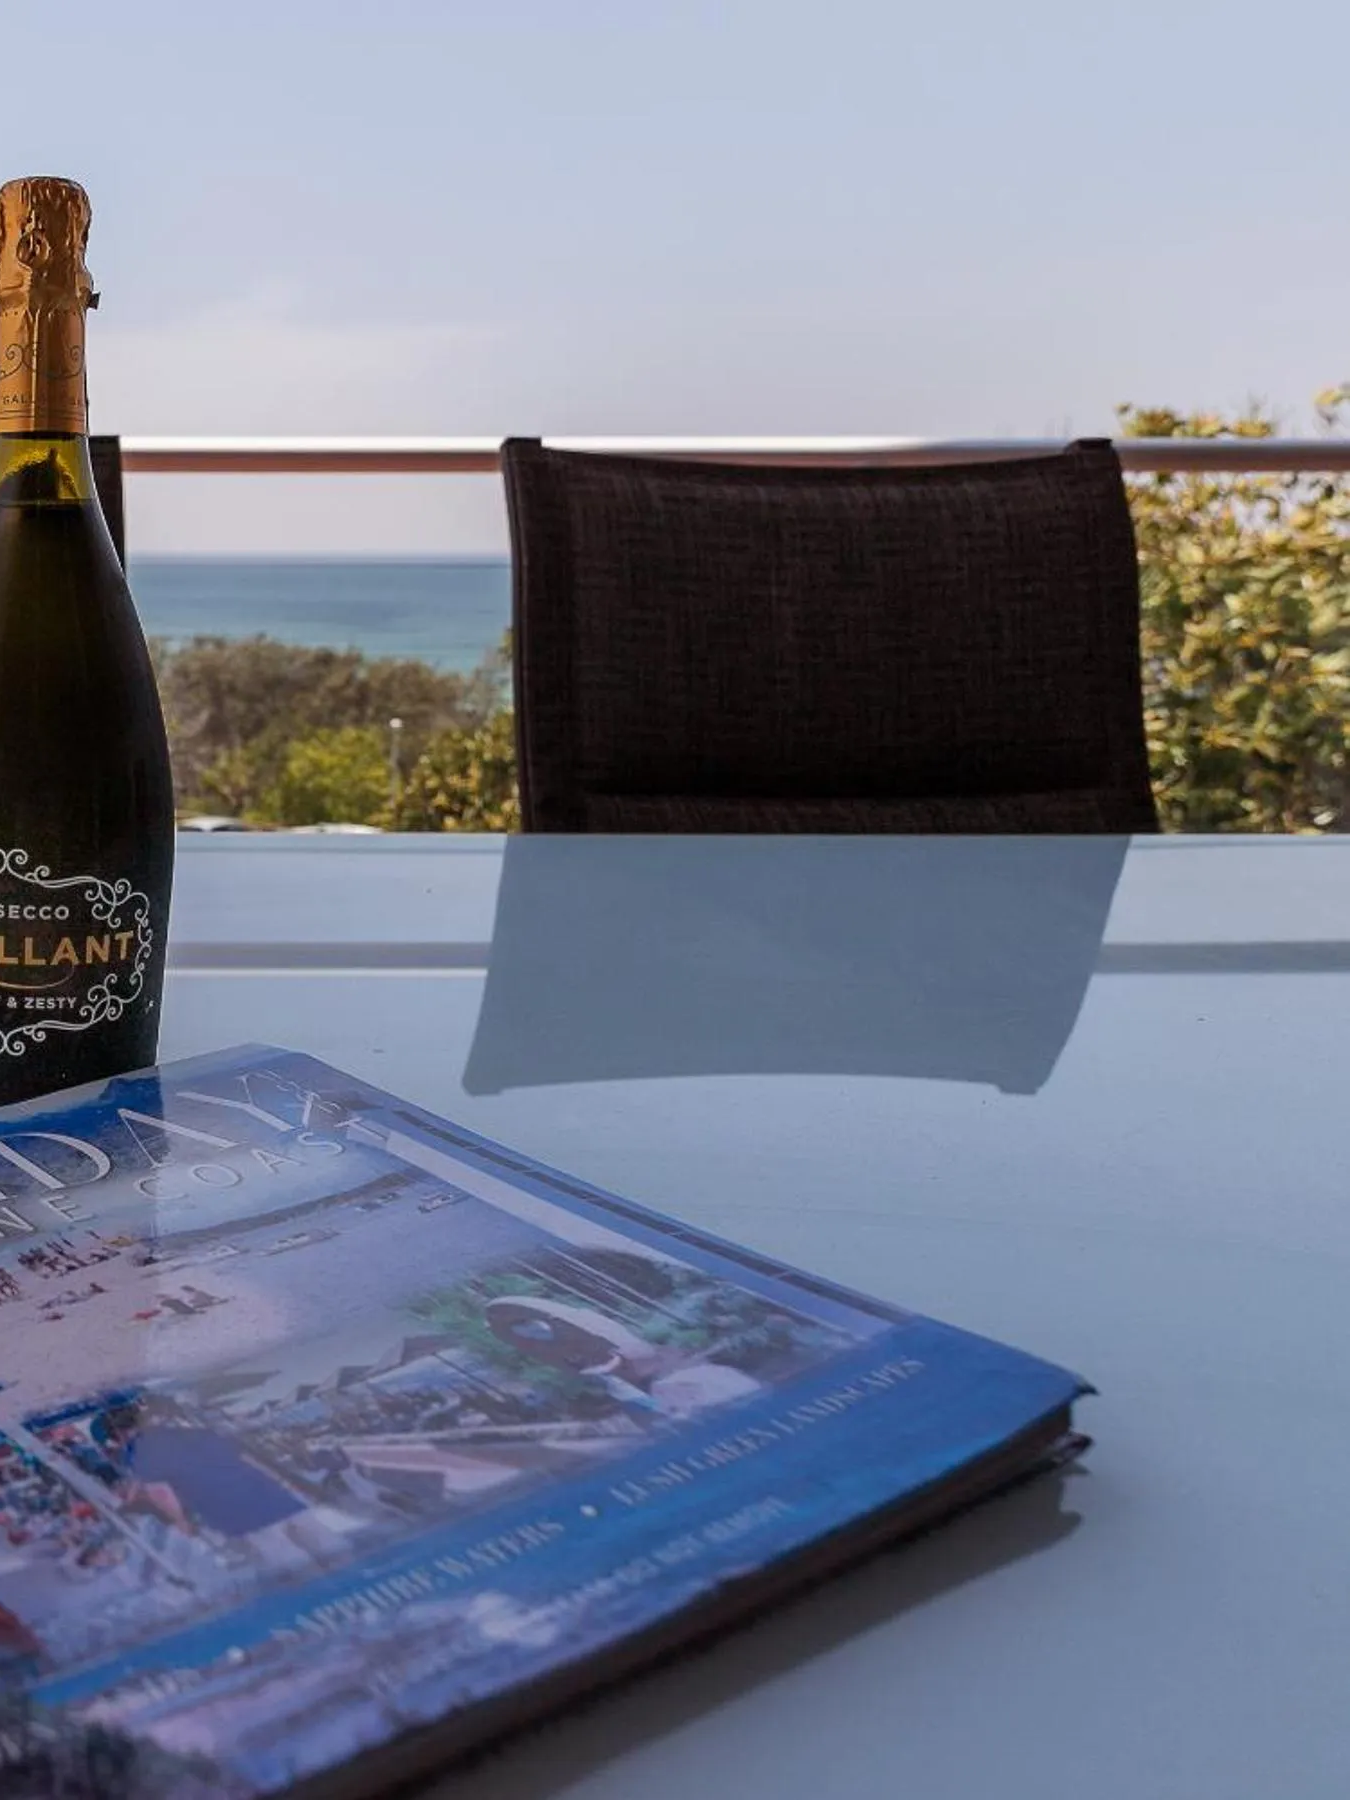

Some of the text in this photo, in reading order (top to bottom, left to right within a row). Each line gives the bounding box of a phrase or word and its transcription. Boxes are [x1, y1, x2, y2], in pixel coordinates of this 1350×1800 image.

[6, 996, 18, 1009] &
[24, 995, 77, 1010] ZESTY
[133, 1116, 388, 1201] COAST
